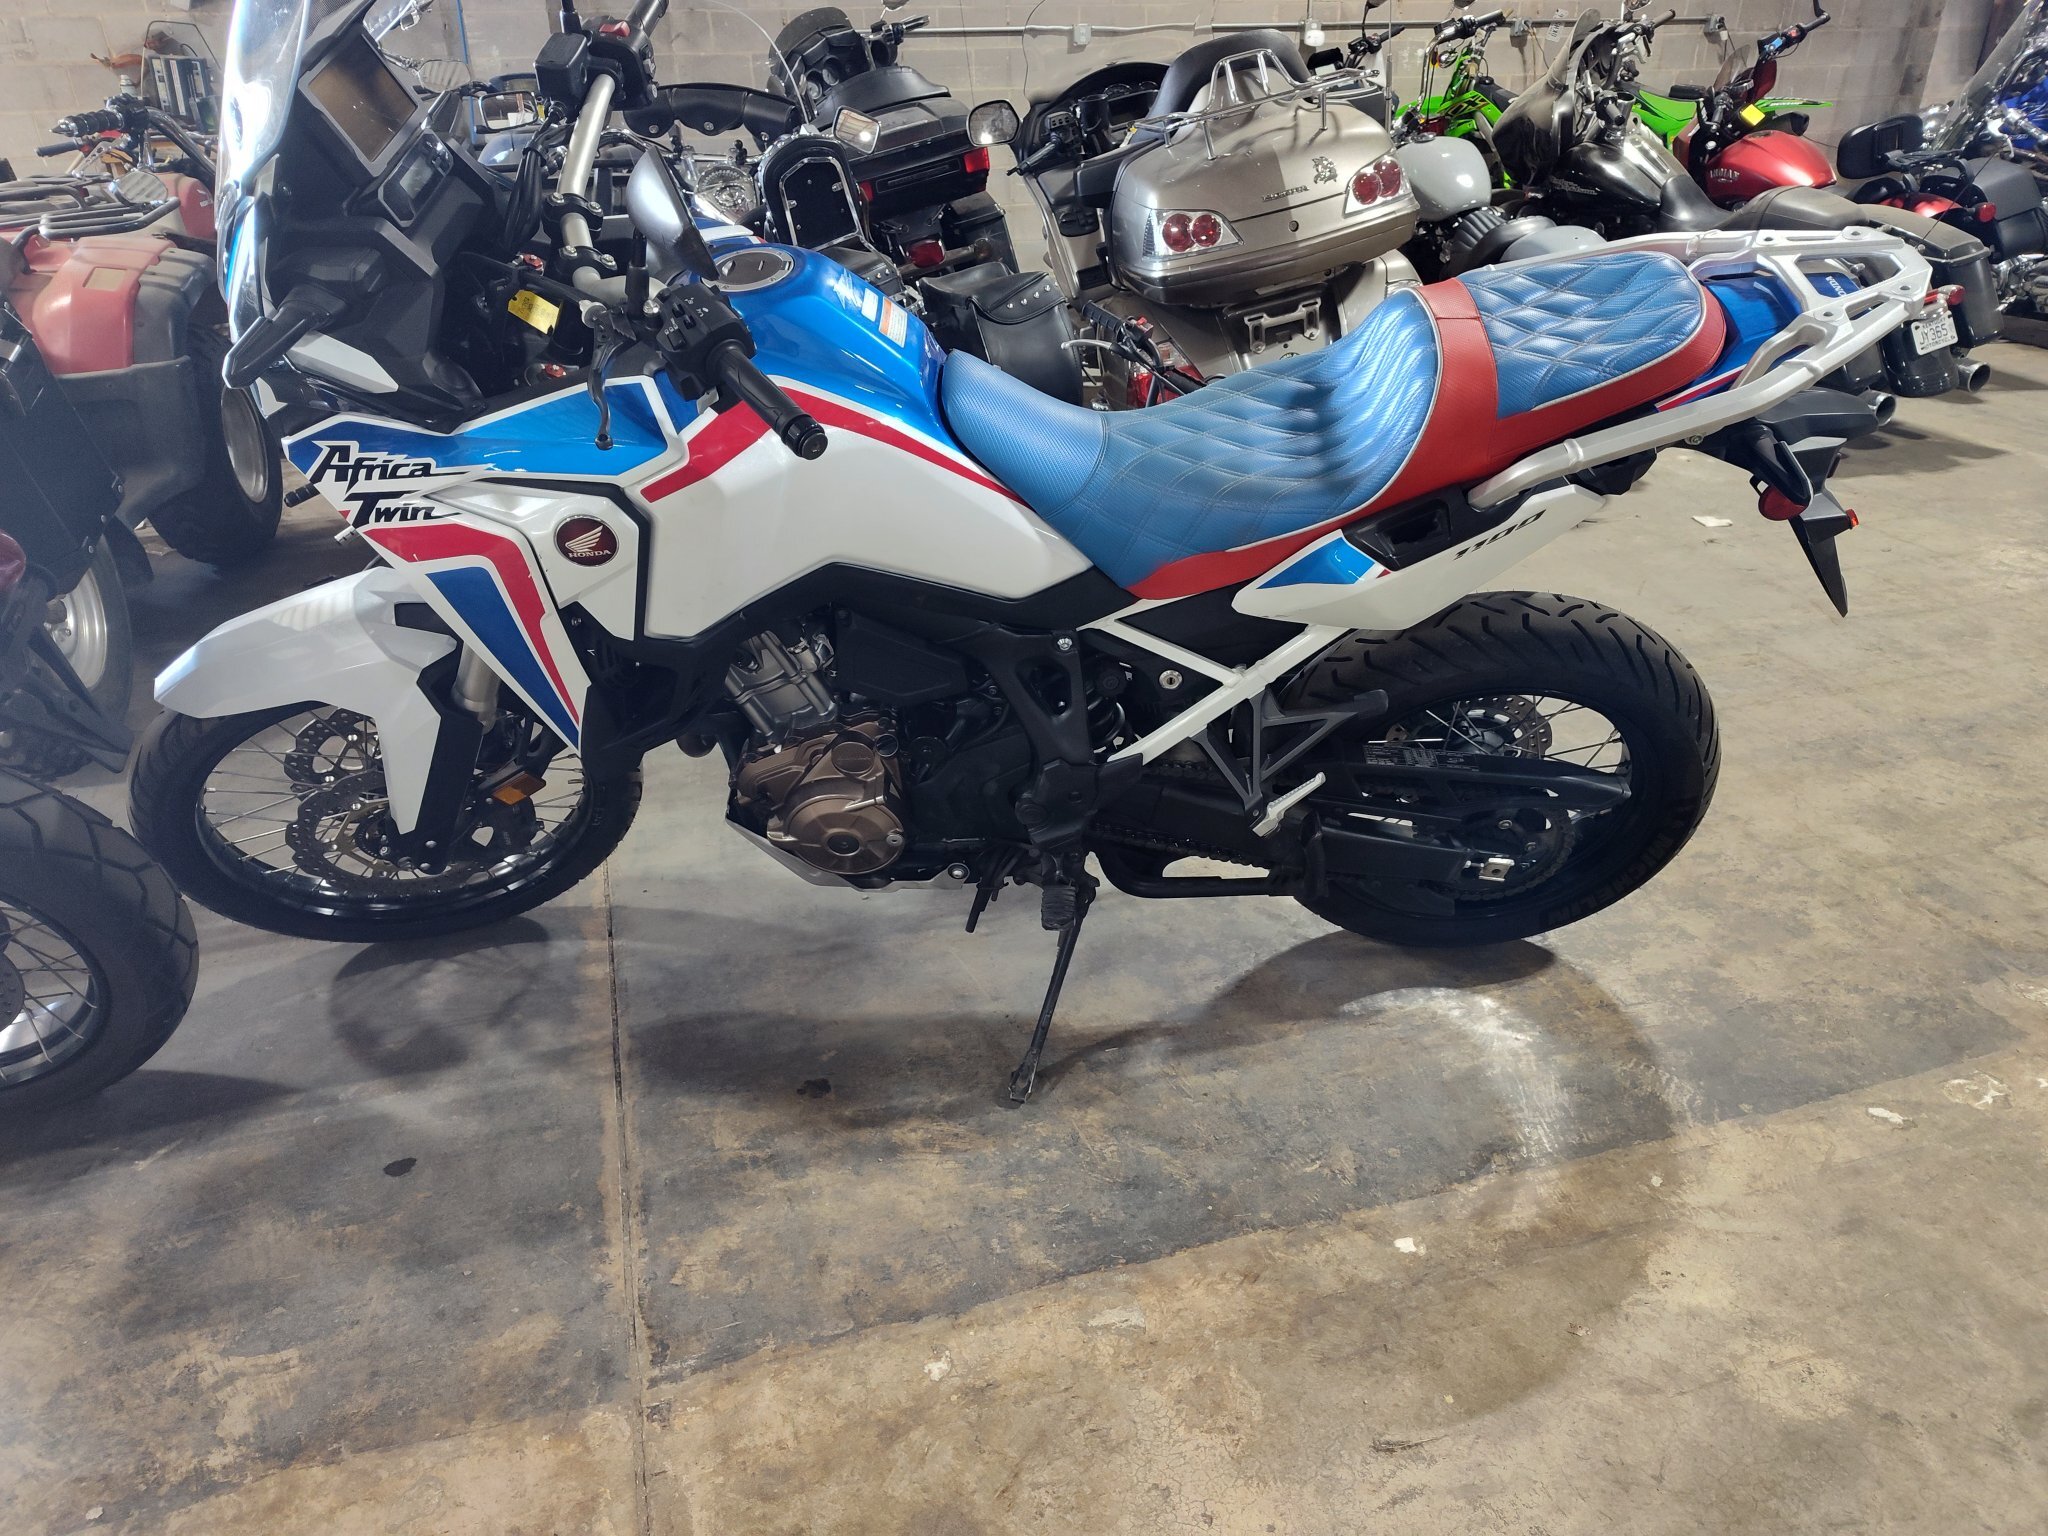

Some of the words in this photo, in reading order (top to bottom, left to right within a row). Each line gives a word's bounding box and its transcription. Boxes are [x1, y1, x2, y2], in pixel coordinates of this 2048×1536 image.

[1825, 275, 1847, 297] ONDA
[1920, 323, 1949, 346] JY365
[309, 445, 468, 495] Africa
[344, 490, 461, 529] Twin
[1453, 508, 1547, 561] 1100
[568, 549, 612, 558] HONDA
